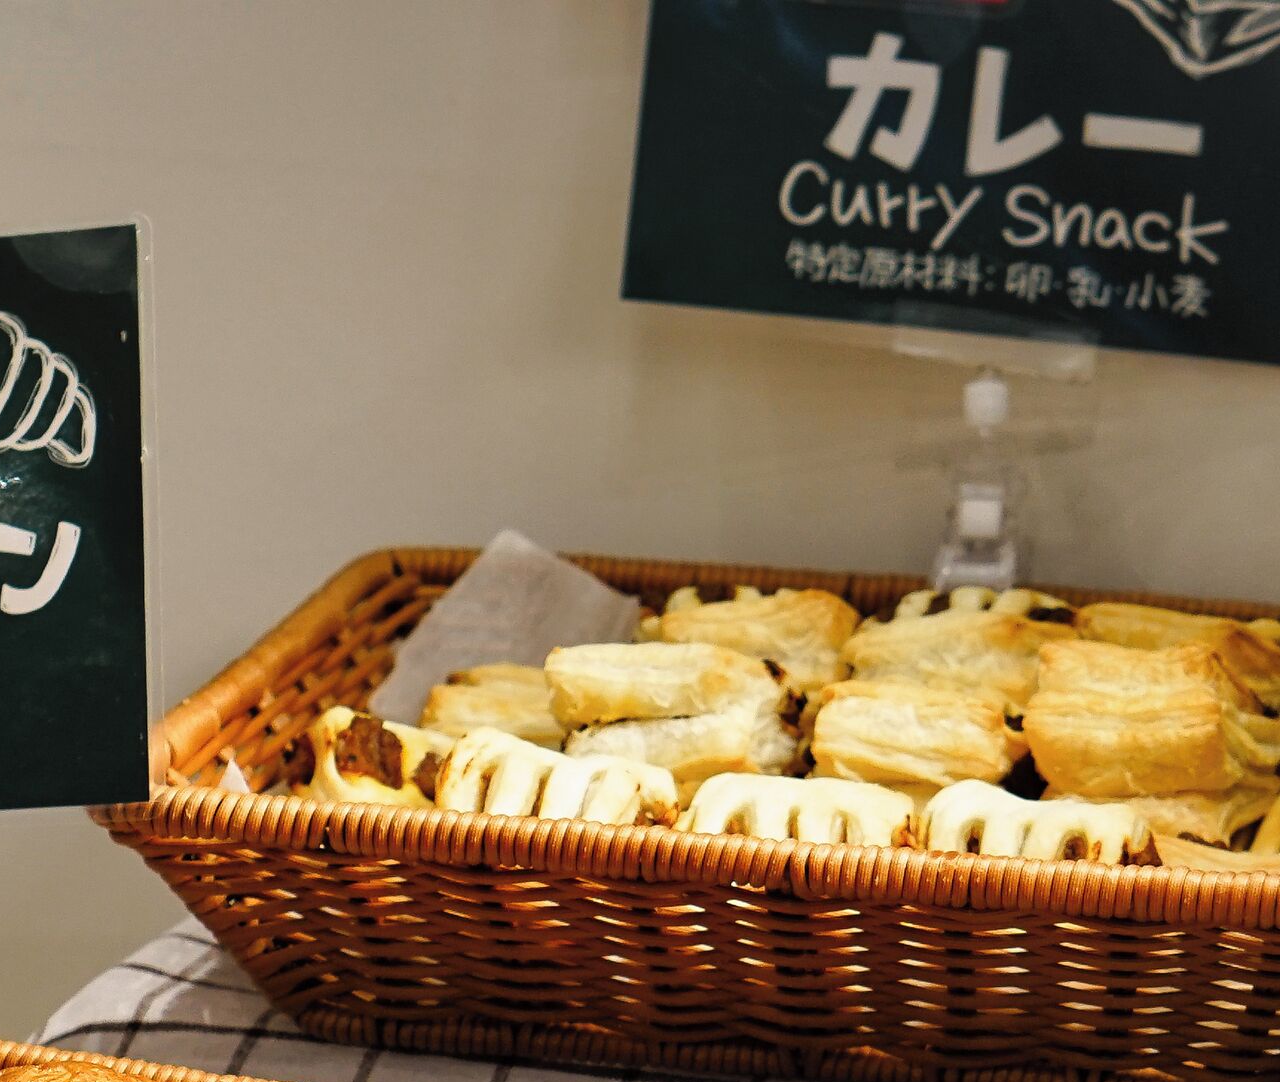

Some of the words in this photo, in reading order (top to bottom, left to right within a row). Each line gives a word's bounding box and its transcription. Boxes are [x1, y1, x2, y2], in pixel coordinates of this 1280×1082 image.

[823, 32, 1203, 177] カレー
[779, 160, 984, 251] Curry
[1002, 184, 1229, 264] Snack
